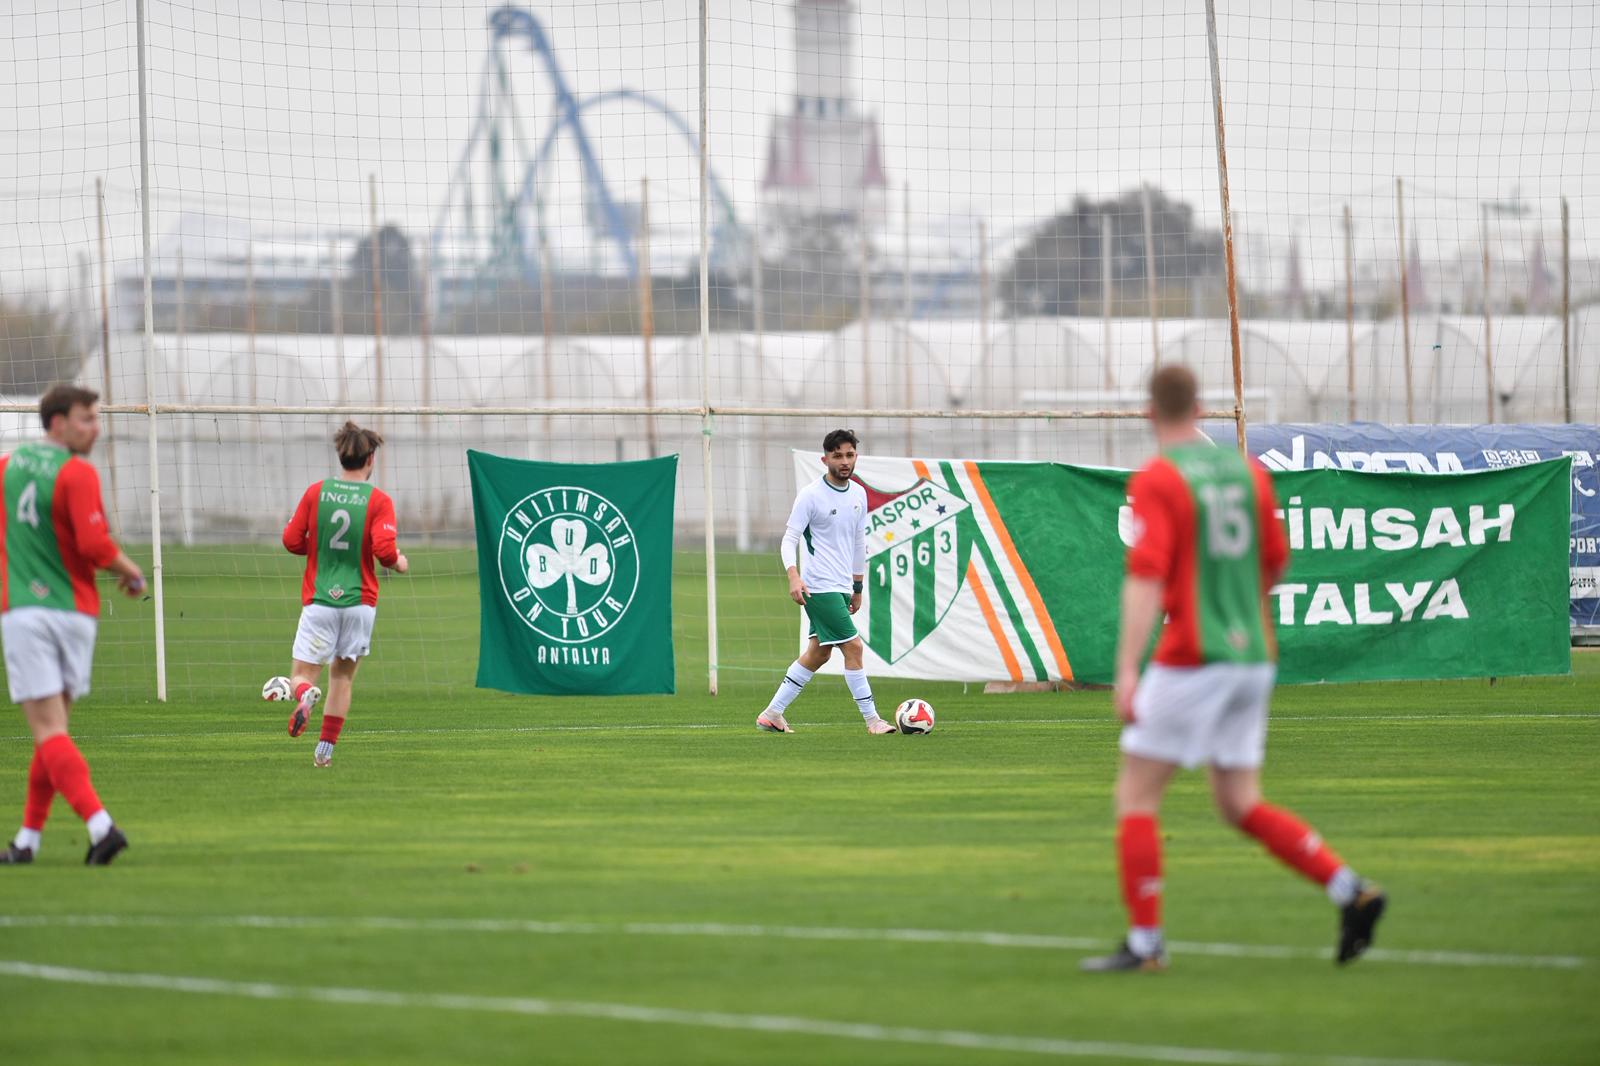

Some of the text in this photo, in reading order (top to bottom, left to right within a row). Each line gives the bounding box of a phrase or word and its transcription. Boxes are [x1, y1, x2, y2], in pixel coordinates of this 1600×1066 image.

[17, 480, 39, 528] 4
[320, 491, 348, 504] ING
[506, 491, 631, 549] UNITIMSAH
[329, 508, 351, 549] 2
[1201, 484, 1251, 560] 15
[876, 530, 952, 587] 1963
[561, 596, 624, 638] TOUR
[1268, 578, 1470, 626] TALYA
[538, 645, 610, 664] ANTALYA
